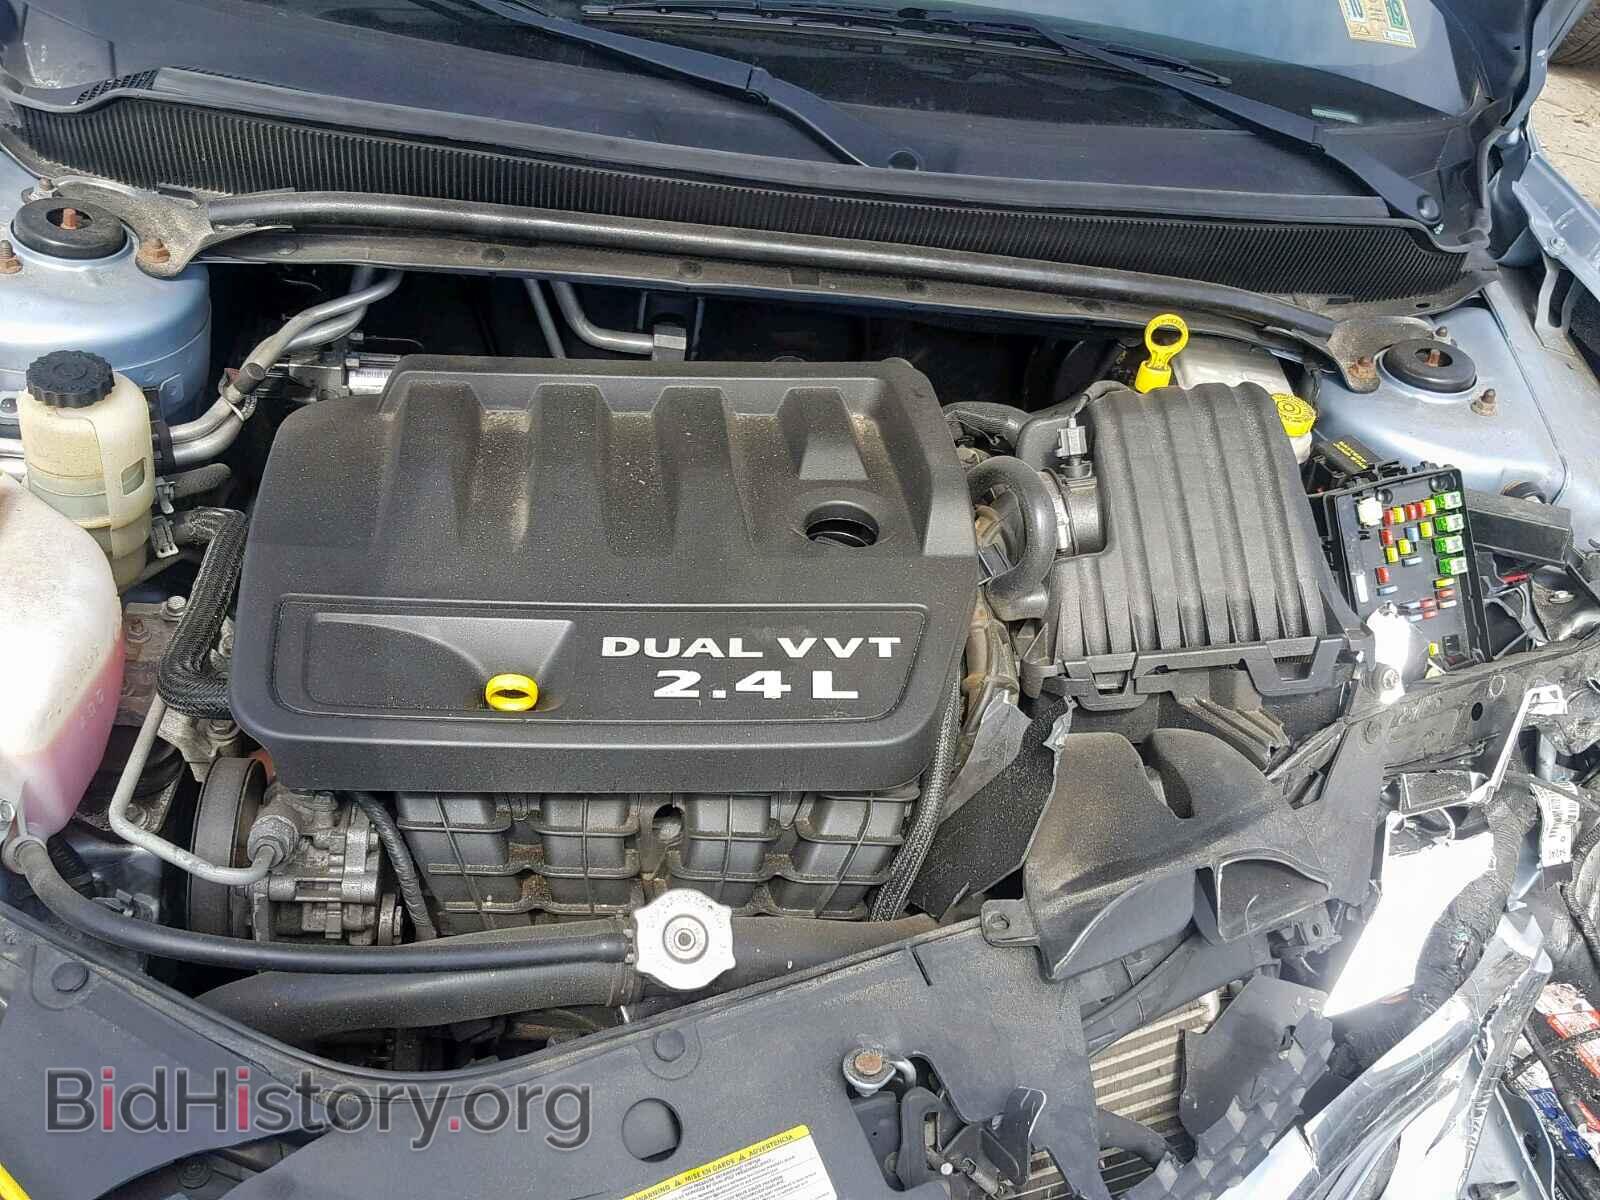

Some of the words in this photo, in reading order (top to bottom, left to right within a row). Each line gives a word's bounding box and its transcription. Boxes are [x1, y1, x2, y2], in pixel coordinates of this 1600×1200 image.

[601, 636, 764, 658] DUAL
[777, 637, 901, 658] VVT
[653, 670, 792, 699] 2.4
